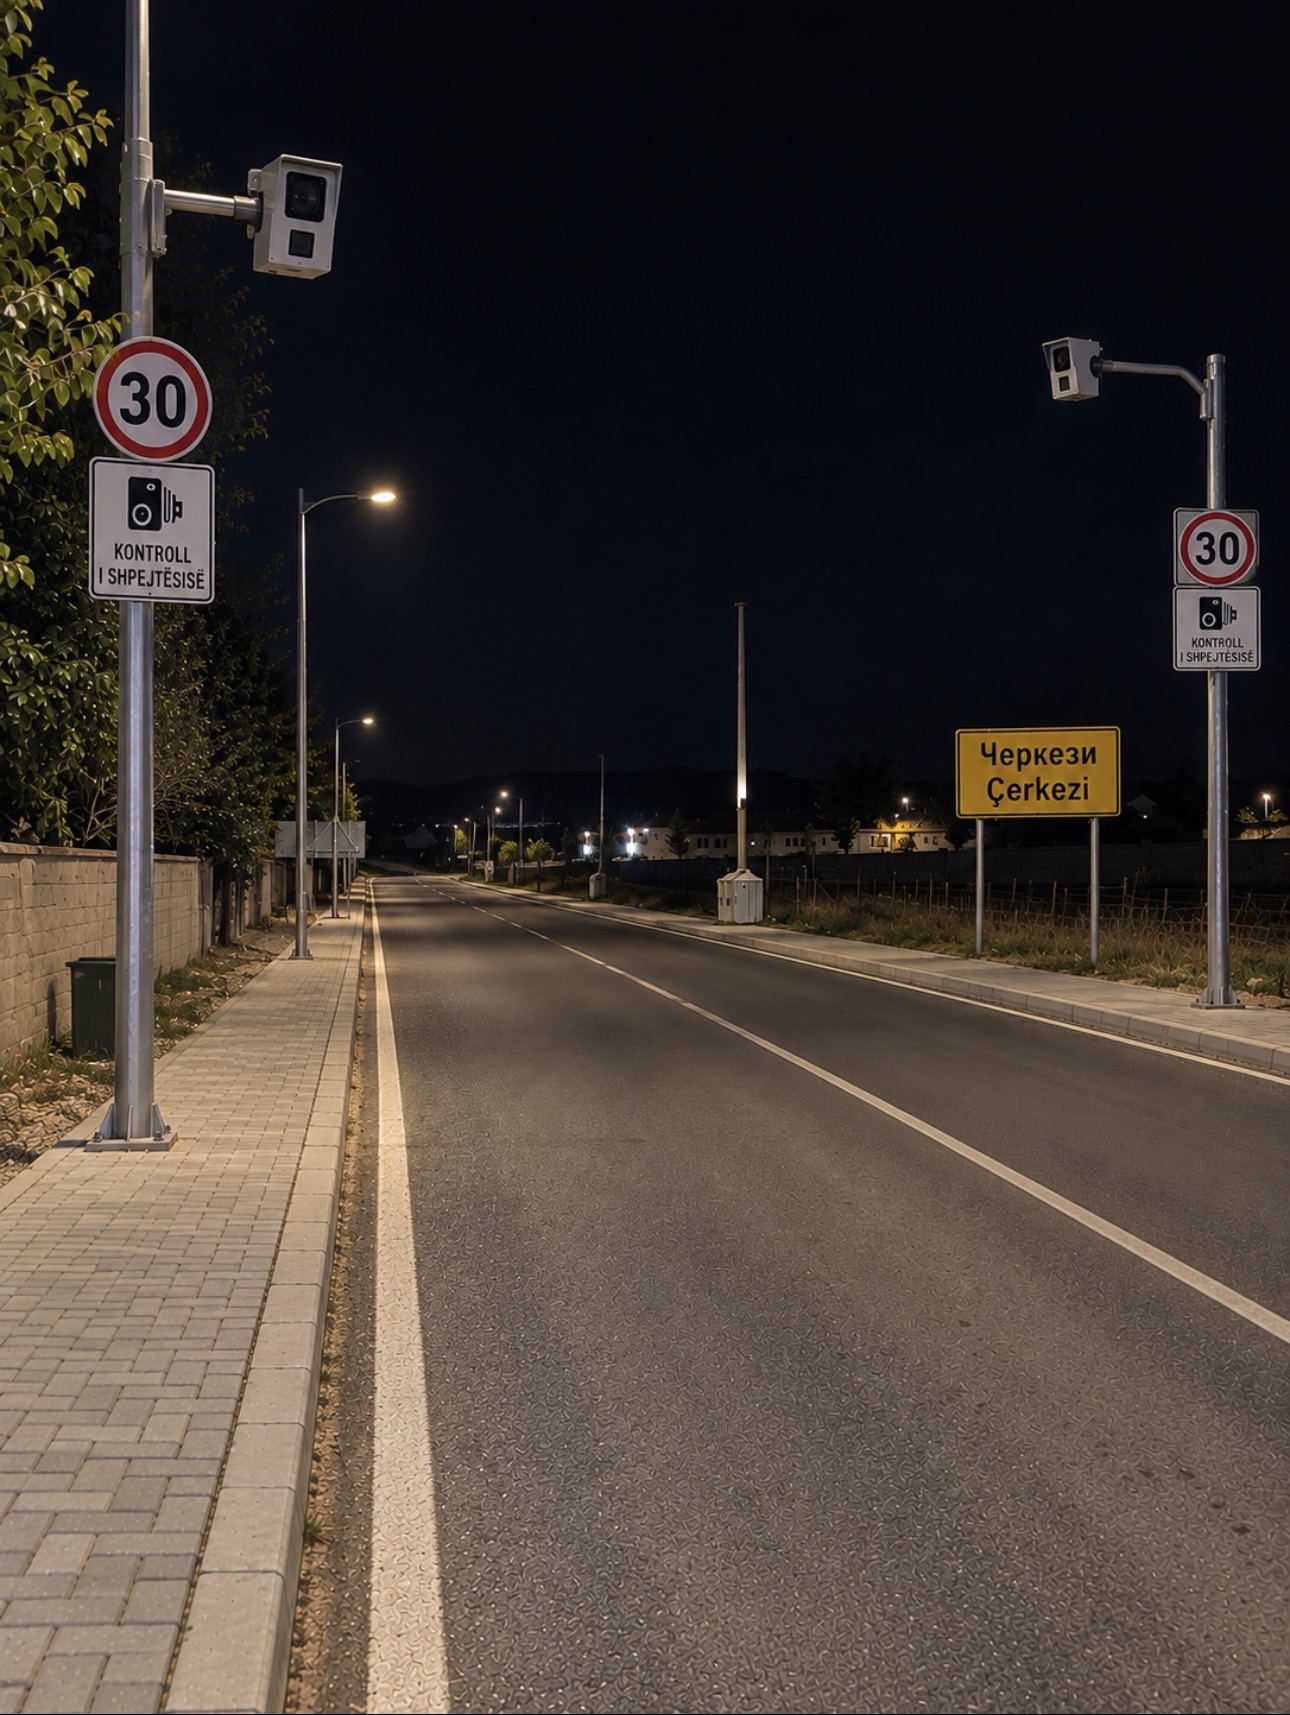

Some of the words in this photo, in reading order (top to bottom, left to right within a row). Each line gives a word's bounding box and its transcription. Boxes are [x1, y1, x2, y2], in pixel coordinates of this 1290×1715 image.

[120, 371, 186, 428] 30
[114, 543, 191, 563] KONTROLL
[1195, 531, 1240, 565] 30
[98, 567, 103, 584] I
[107, 566, 205, 589] SHPEJTËSISË
[1191, 637, 1243, 648] KONTROLL
[980, 742, 1096, 772] Черкези
[987, 776, 1088, 807] Çerkezi
